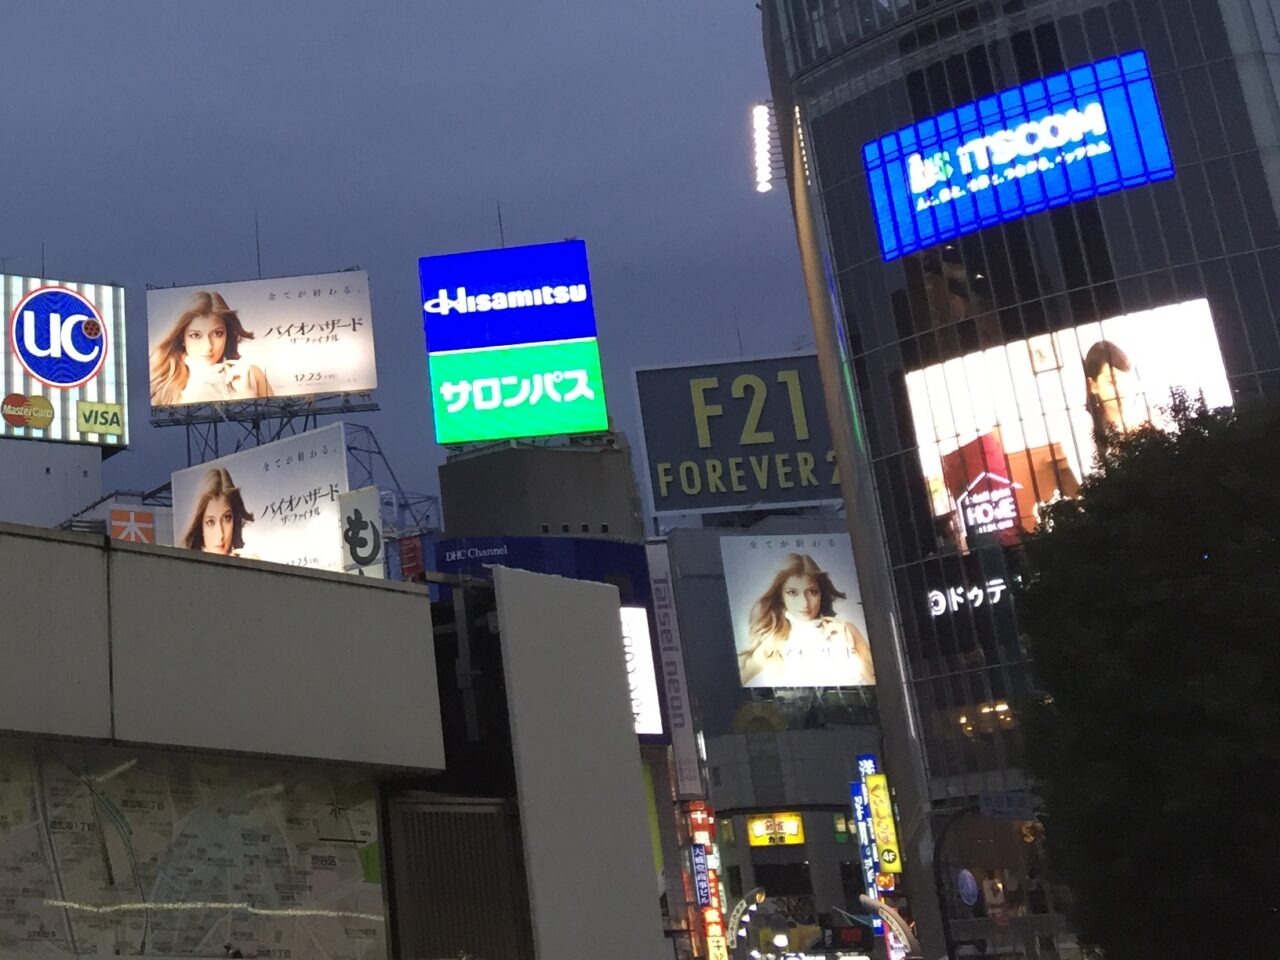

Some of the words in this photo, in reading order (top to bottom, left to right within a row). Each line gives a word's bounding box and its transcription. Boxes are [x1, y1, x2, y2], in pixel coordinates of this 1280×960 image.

[424, 284, 587, 315] Hisamitsu
[23, 310, 99, 363] UC
[264, 317, 363, 339] バイオハザード
[440, 369, 595, 413] サロンパス
[3, 404, 52, 418] MasterCard
[82, 409, 120, 427] VISA
[690, 370, 810, 449] F21
[657, 450, 819, 497] FOREVER
[261, 484, 339, 519] バイオハザード
[446, 549, 466, 562] DHC
[467, 544, 508, 558] Channel
[665, 660, 685, 729] neon
[883, 851, 896, 862] 4F
